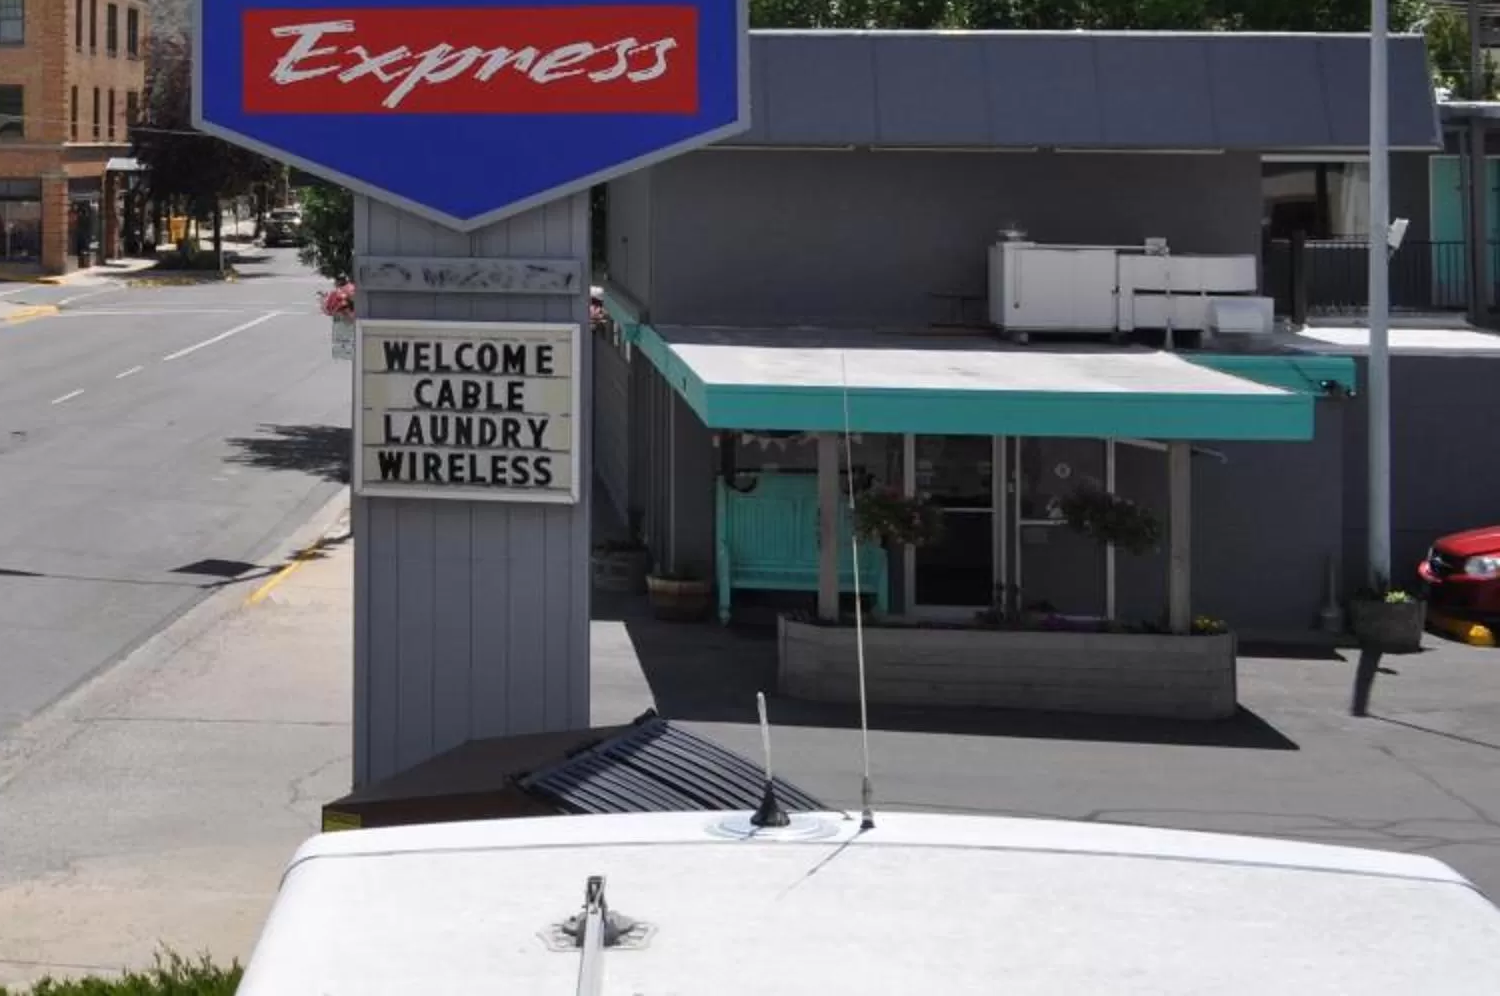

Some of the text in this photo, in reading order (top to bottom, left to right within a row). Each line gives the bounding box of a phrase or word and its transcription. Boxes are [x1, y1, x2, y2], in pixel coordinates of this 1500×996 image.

[270, 19, 678, 109] Express
[383, 340, 553, 374] WELCOME
[414, 379, 525, 412] CABLE
[383, 414, 549, 449] LAUNDRY
[377, 450, 552, 485] WIRELESS
